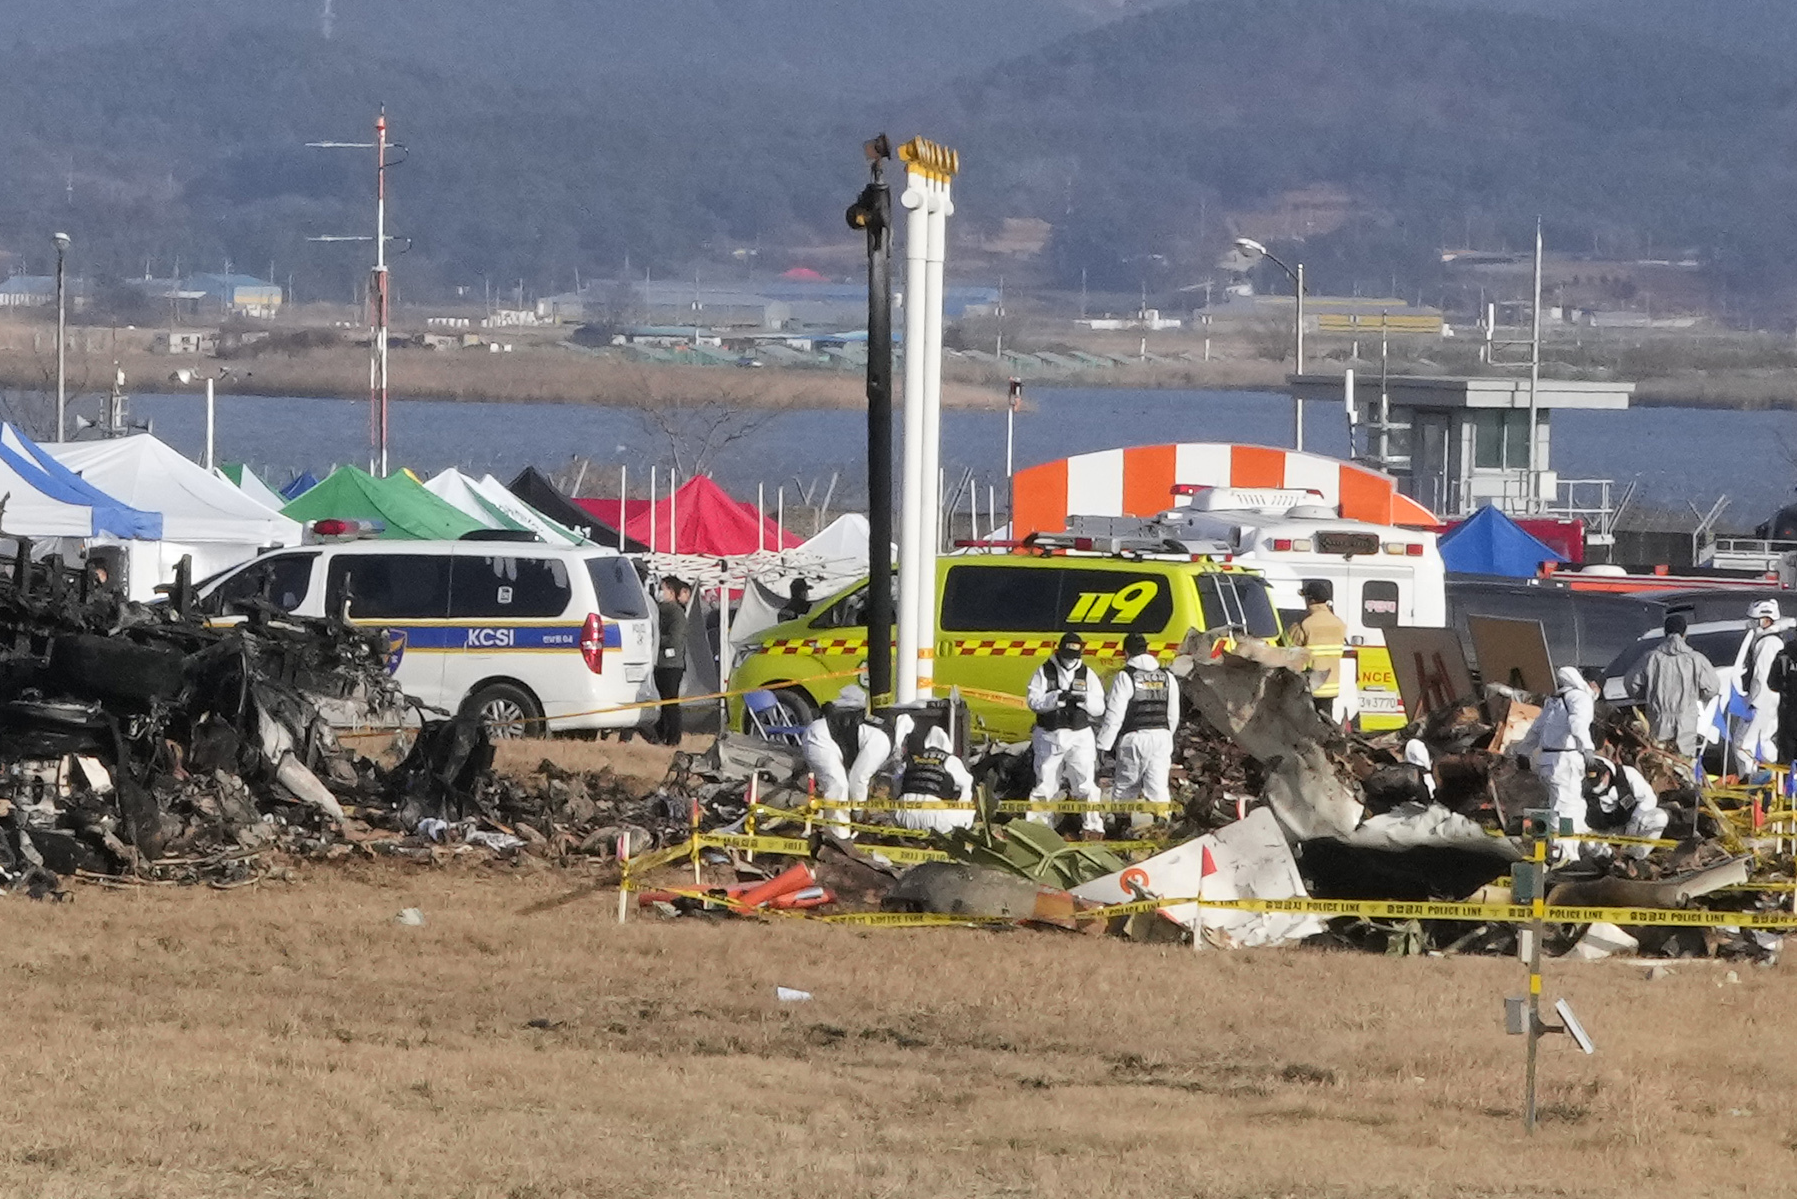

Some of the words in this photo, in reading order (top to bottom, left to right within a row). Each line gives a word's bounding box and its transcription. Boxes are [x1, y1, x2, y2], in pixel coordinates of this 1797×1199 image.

[1065, 581, 1159, 623] 119
[467, 628, 515, 647] KCSI
[1306, 902, 1338, 912] POLICE
[1341, 903, 1360, 912] LINE
[1427, 905, 1459, 916] POLICE
[1462, 906, 1482, 917] LINE
[1549, 908, 1581, 919] POLICE
[1583, 909, 1604, 920] LINE
[1671, 912, 1702, 923] POLICE
[1705, 913, 1725, 923] LINE
